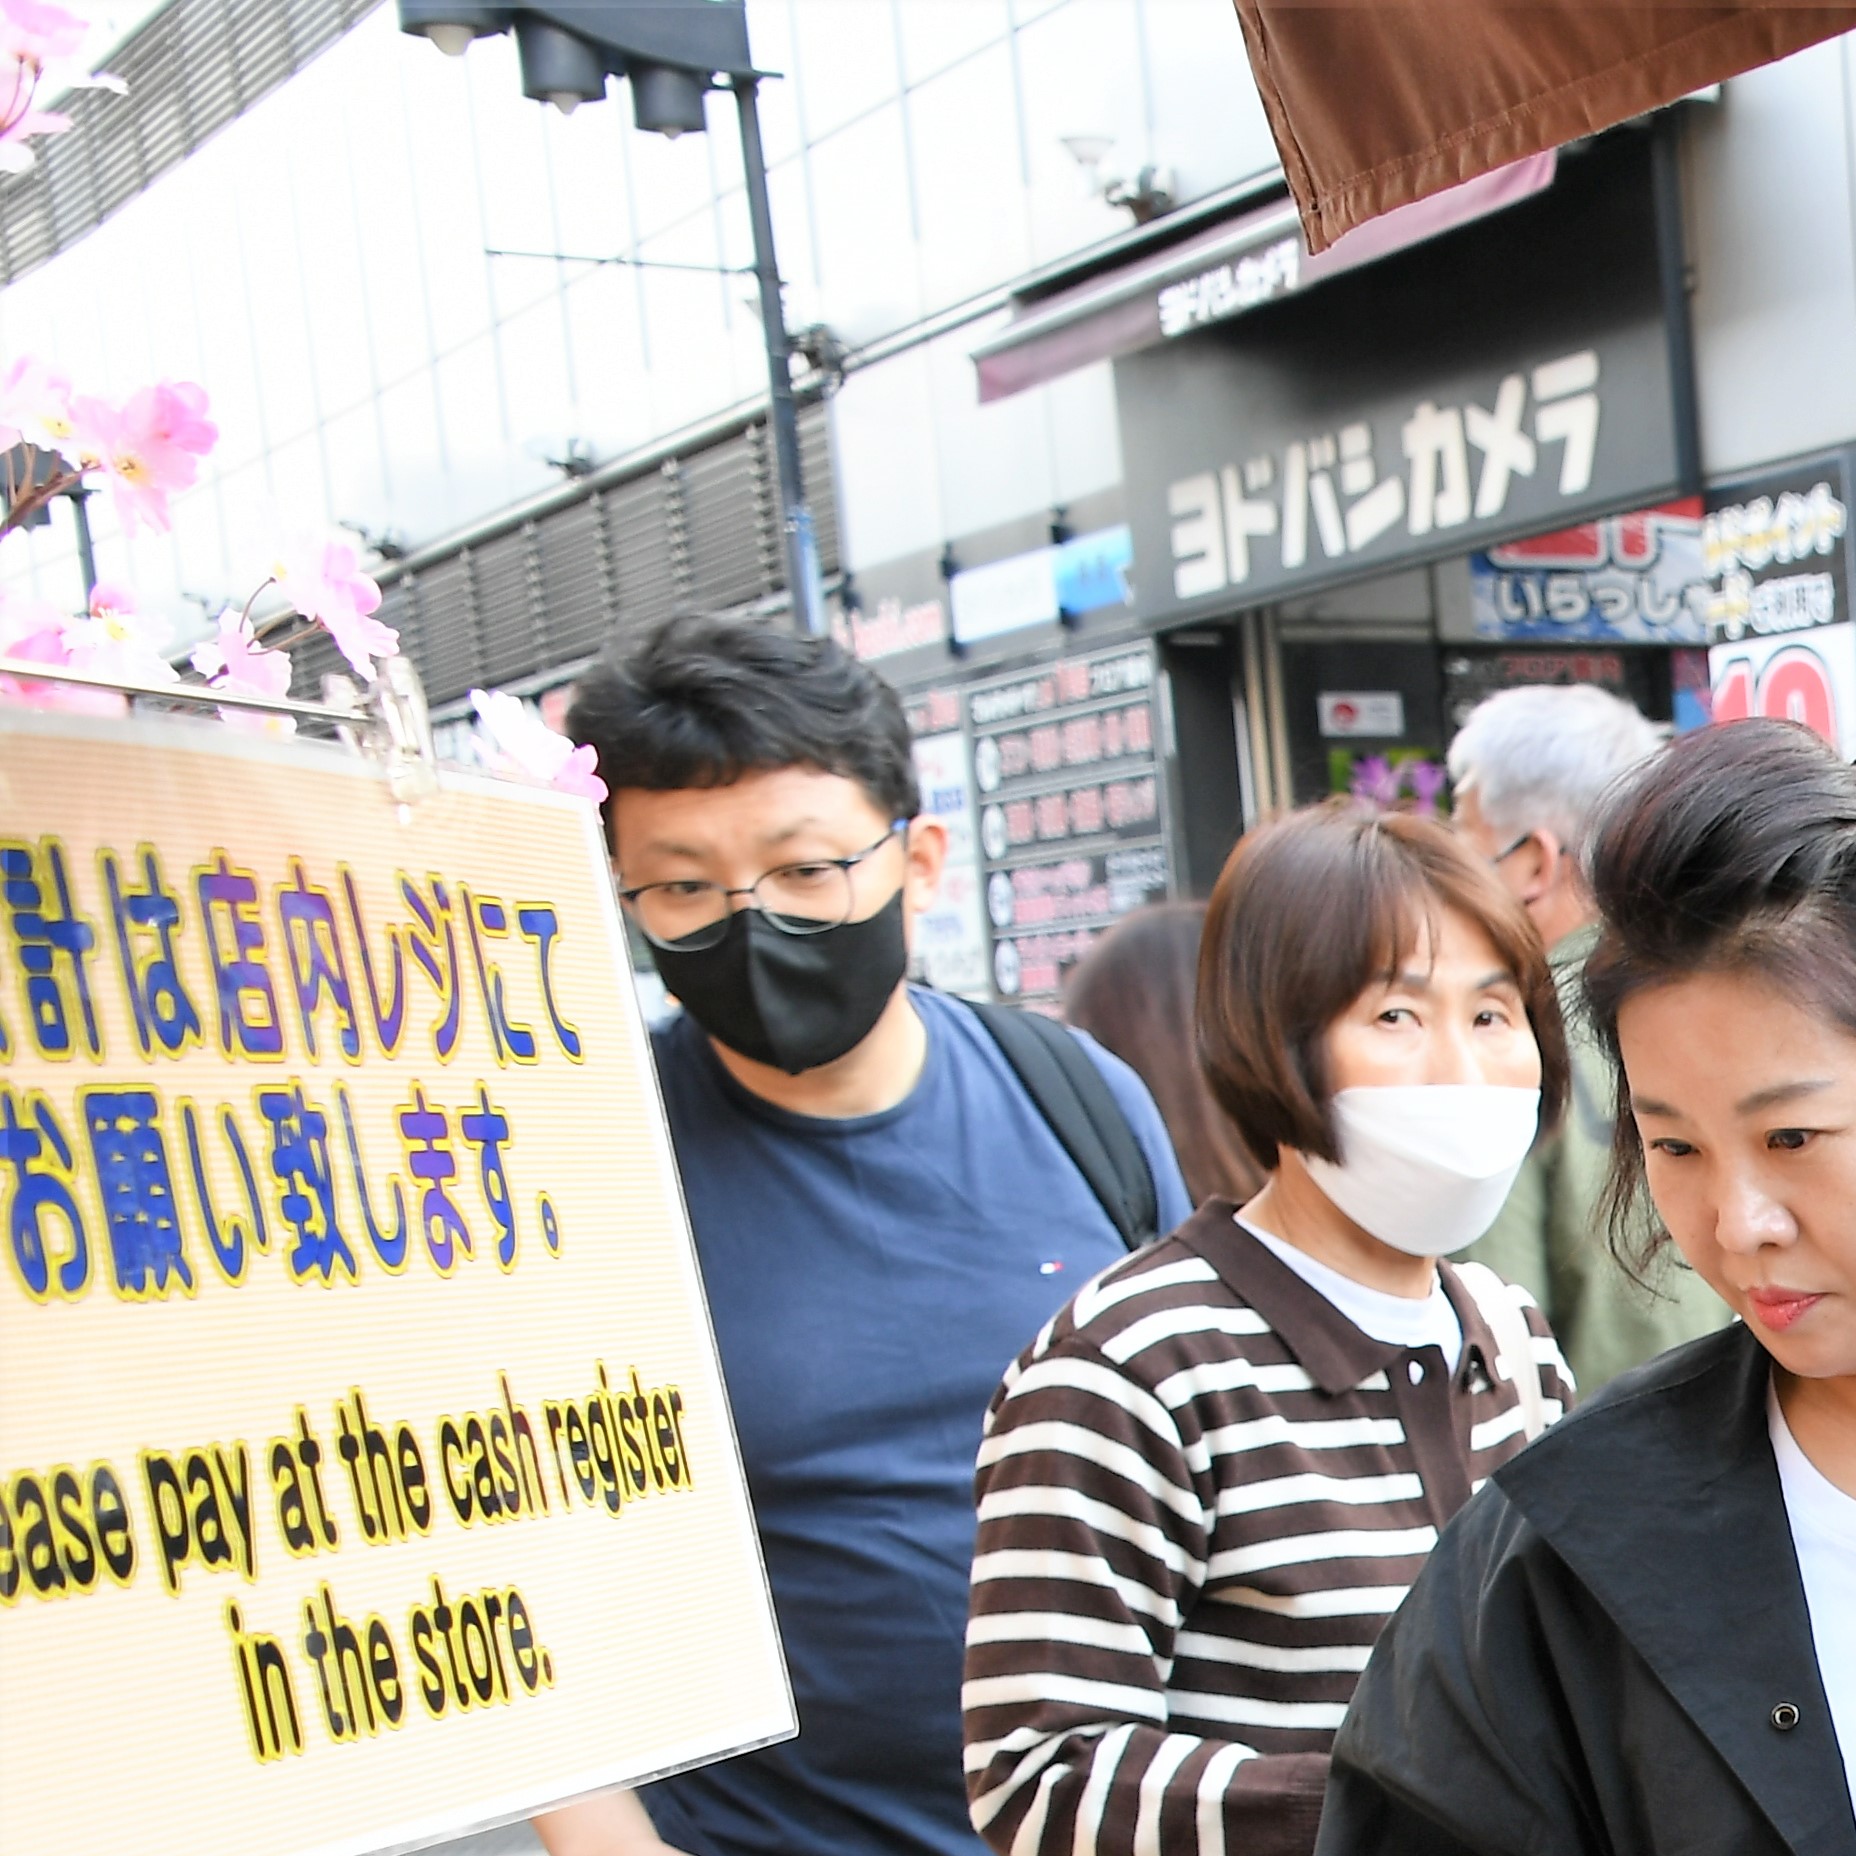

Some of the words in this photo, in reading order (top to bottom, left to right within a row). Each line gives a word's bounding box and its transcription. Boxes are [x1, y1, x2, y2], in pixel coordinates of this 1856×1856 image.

[1168, 350, 1599, 600] ヨドバシカメラ
[0, 834, 585, 1068] 計は店内レジにて
[0, 1076, 563, 1305] お願い致します。
[139, 1438, 260, 1598] pay
[267, 1404, 341, 1559] at
[336, 1384, 432, 1546] the
[437, 1369, 550, 1530] cash
[543, 1359, 696, 1520] register
[223, 1596, 305, 1765] in
[303, 1579, 406, 1745] the
[408, 1572, 557, 1723] store.
